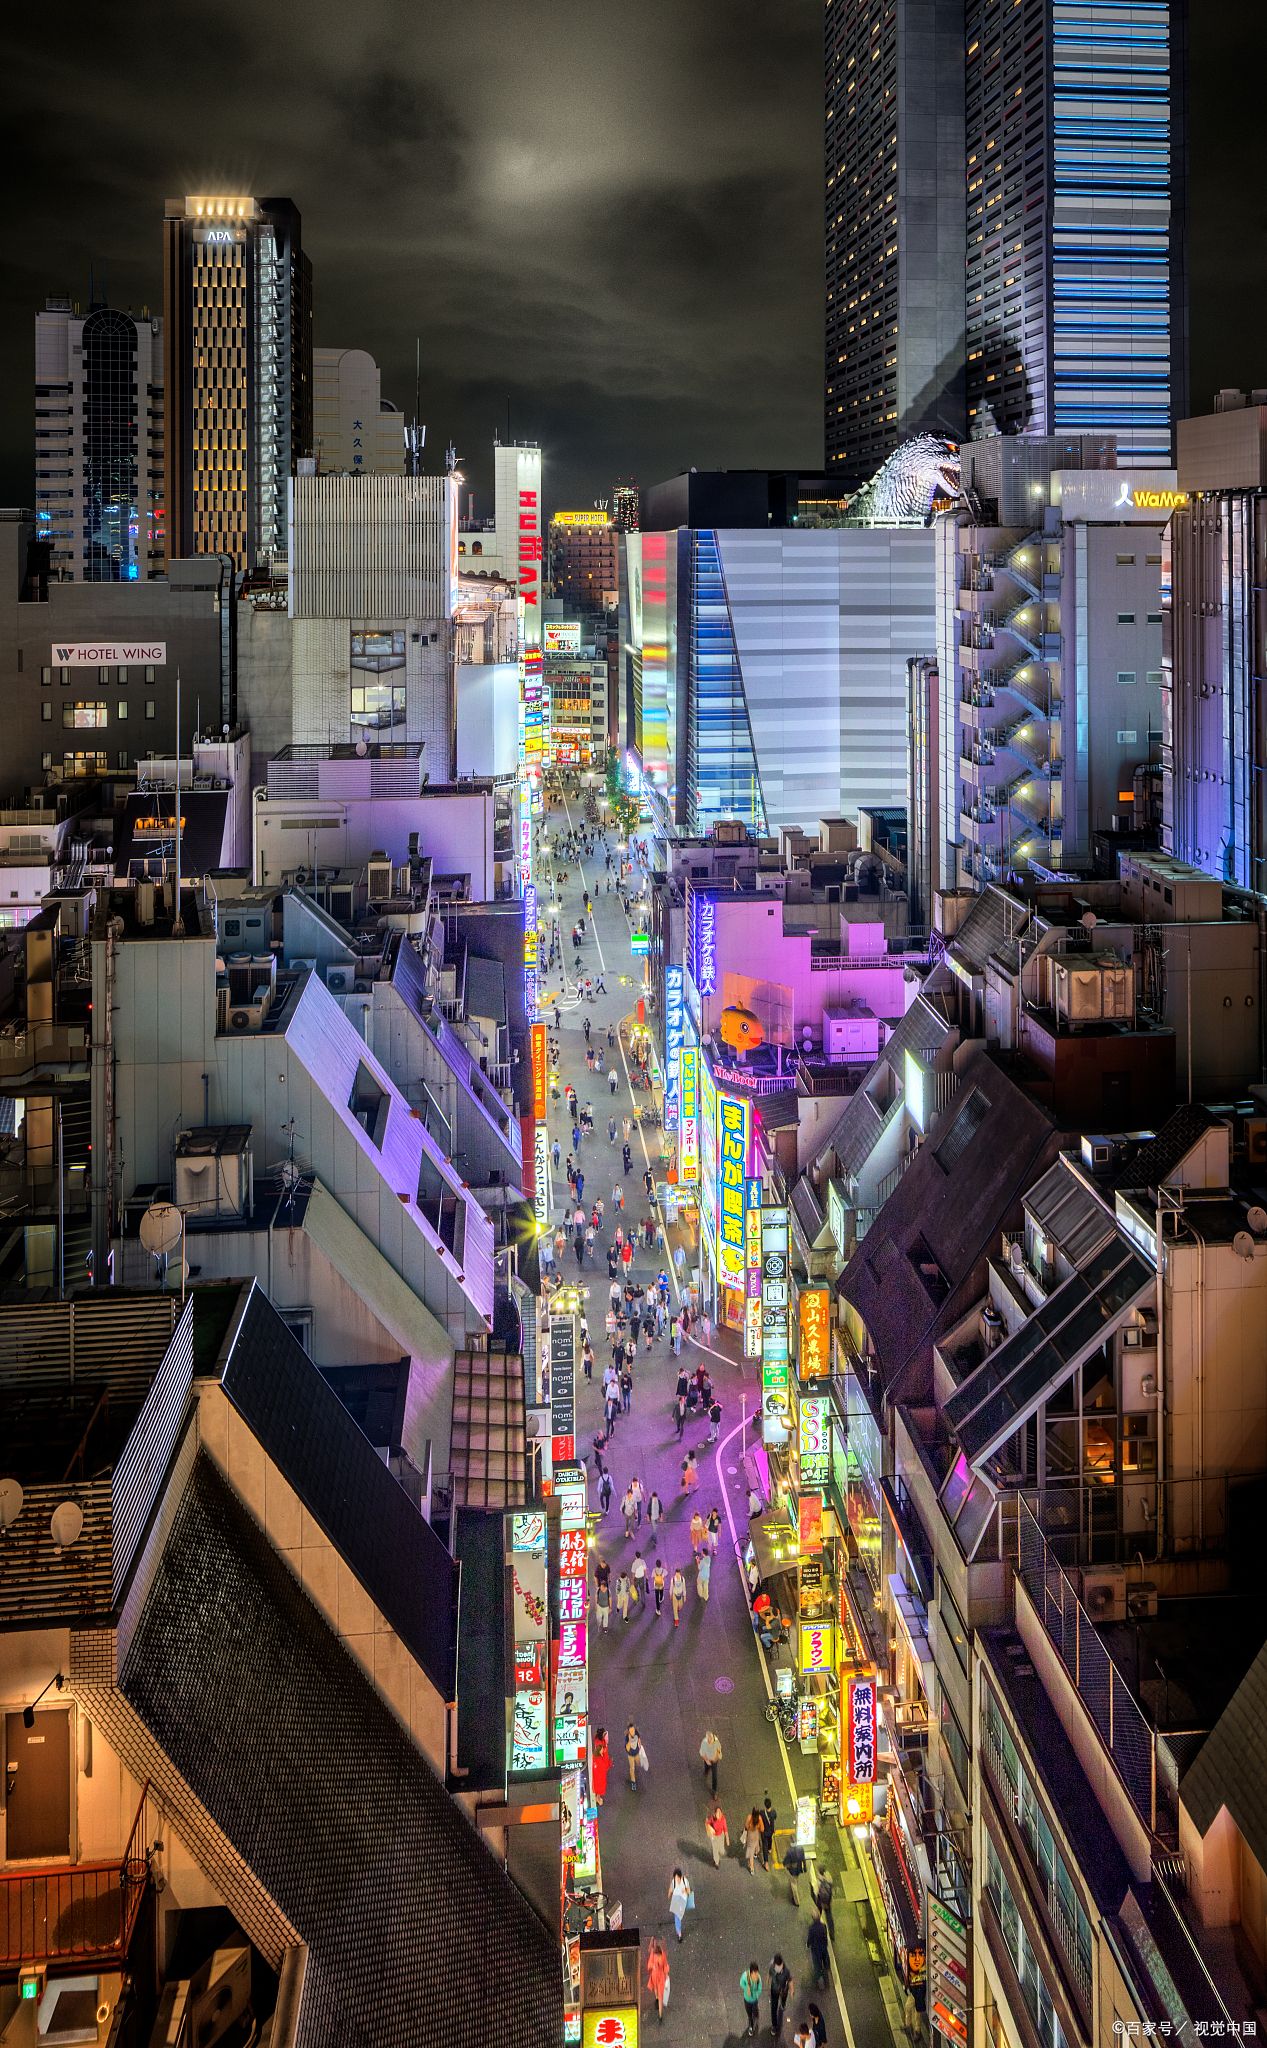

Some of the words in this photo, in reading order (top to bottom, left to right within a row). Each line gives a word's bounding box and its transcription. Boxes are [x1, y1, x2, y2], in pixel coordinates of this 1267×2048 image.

[208, 231, 231, 240] APA
[574, 514, 589, 522] SUPER
[590, 514, 605, 522] HOTEL
[78, 649, 118, 660] HOTEL
[122, 648, 162, 659] WING
[702, 903, 716, 994] カラオケの鉄人
[722, 1103, 744, 1246] まんが喫茶
[813, 1469, 829, 1480] 4F
[532, 1552, 543, 1560] 6F
[571, 1578, 583, 1619] レンタル
[807, 1608, 817, 1616] 2F
[810, 1631, 823, 1666] クラウン
[854, 1687, 873, 1779] 無料案内所
